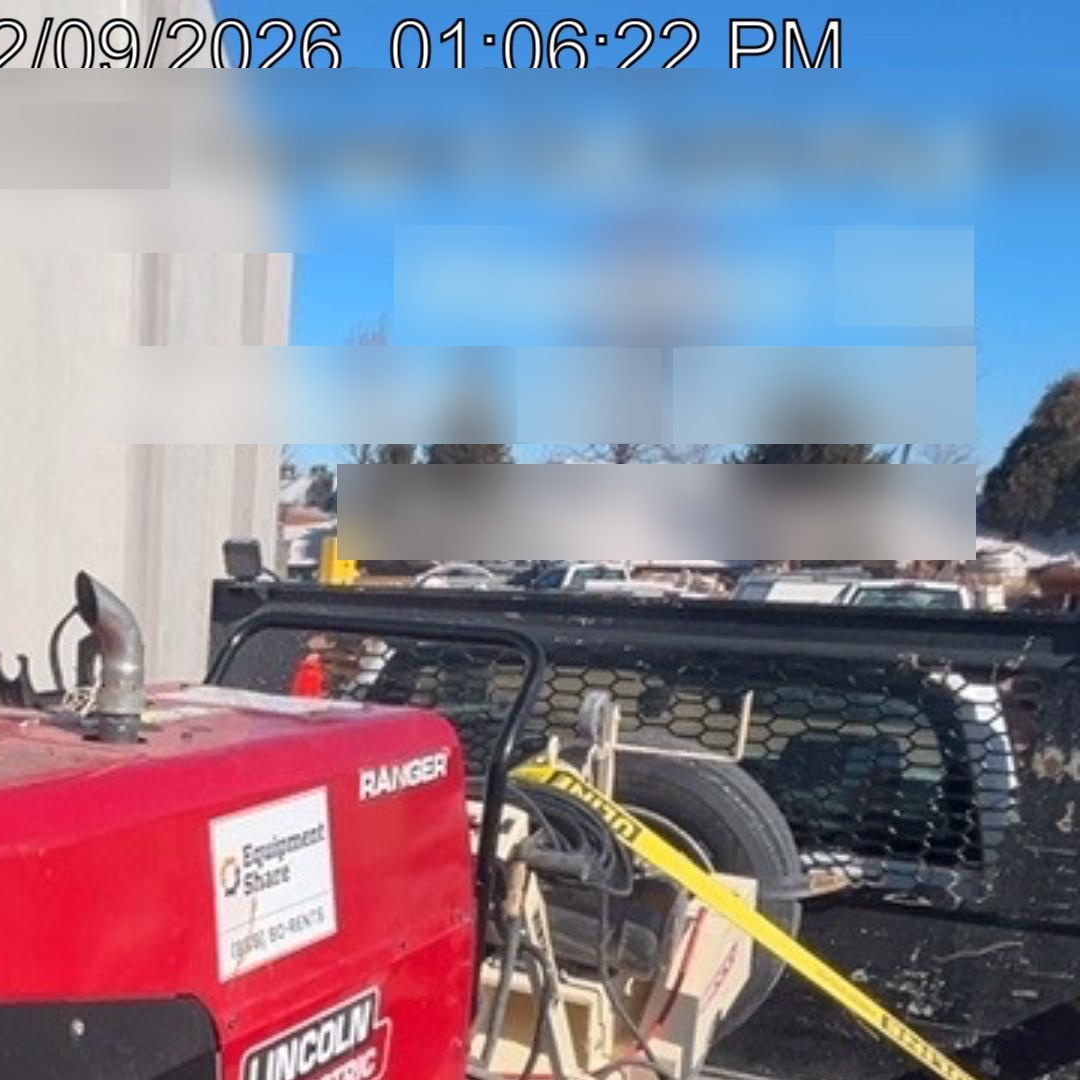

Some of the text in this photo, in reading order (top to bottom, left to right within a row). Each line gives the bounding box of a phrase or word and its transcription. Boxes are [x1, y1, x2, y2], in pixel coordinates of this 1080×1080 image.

[359, 751, 448, 800] RANGER
[242, 824, 325, 868] Equipment
[243, 864, 290, 897] Share
